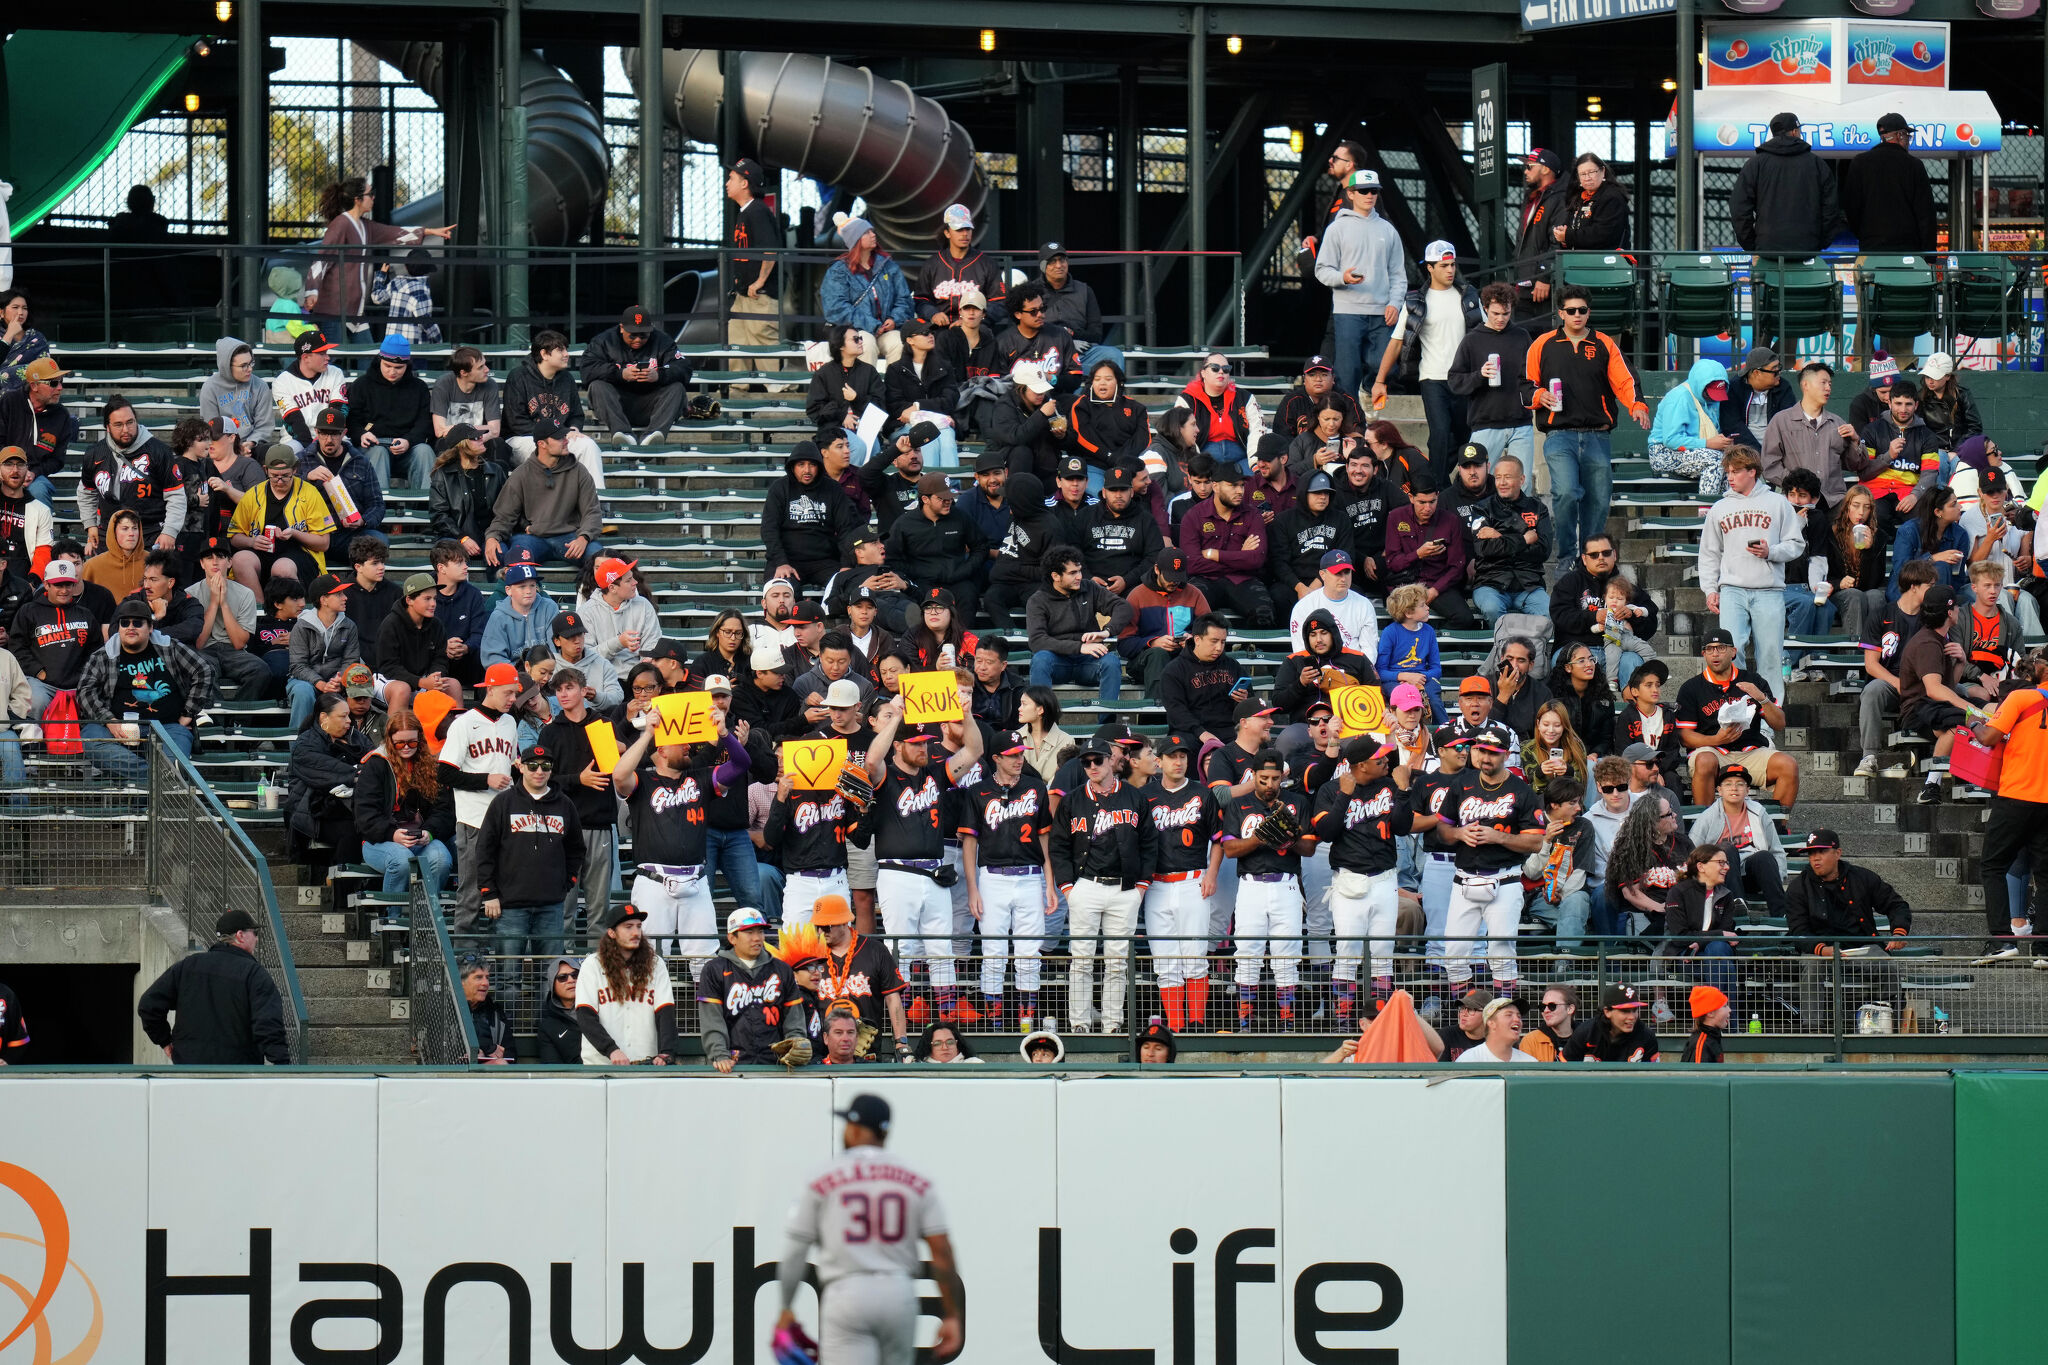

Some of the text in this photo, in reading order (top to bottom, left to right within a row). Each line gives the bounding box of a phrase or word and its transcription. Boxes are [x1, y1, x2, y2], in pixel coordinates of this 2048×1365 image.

[1551, 0, 1578, 24] FAN
[1478, 101, 1494, 143] 139
[1748, 122, 1836, 148] TTE
[1842, 125, 1872, 145] the
[1585, 346, 1597, 361] SF
[293, 388, 331, 409] GIANTS
[136, 484, 152, 498] 51
[1719, 513, 1772, 535] GIANTS
[522, 566, 533, 578] B
[63, 620, 89, 631] RANCISCO
[37, 631, 72, 646] GIANTS
[902, 681, 960, 715] KRUK
[658, 702, 705, 736] WE
[1818, 755, 1832, 768] 14
[651, 777, 701, 814] Giants
[898, 775, 940, 817] Giants
[686, 807, 705, 826] 44
[929, 808, 939, 829] 5
[985, 788, 1038, 830] Giants
[1152, 796, 1202, 832] Giants
[1344, 788, 1394, 831] Giants
[1459, 792, 1514, 827] Giants
[1878, 808, 1892, 821] 12
[511, 814, 565, 834] SAN FRNCISCO
[1020, 823, 1033, 843] 2
[1182, 828, 1194, 847] 0
[1909, 837, 1922, 850] 11
[304, 889, 314, 902] 9
[374, 971, 383, 986] 6
[726, 973, 781, 1016] Giants
[398, 1002, 407, 1017] 5
[841, 1192, 907, 1244] 30
[1038, 1226, 1404, 1365] Life
